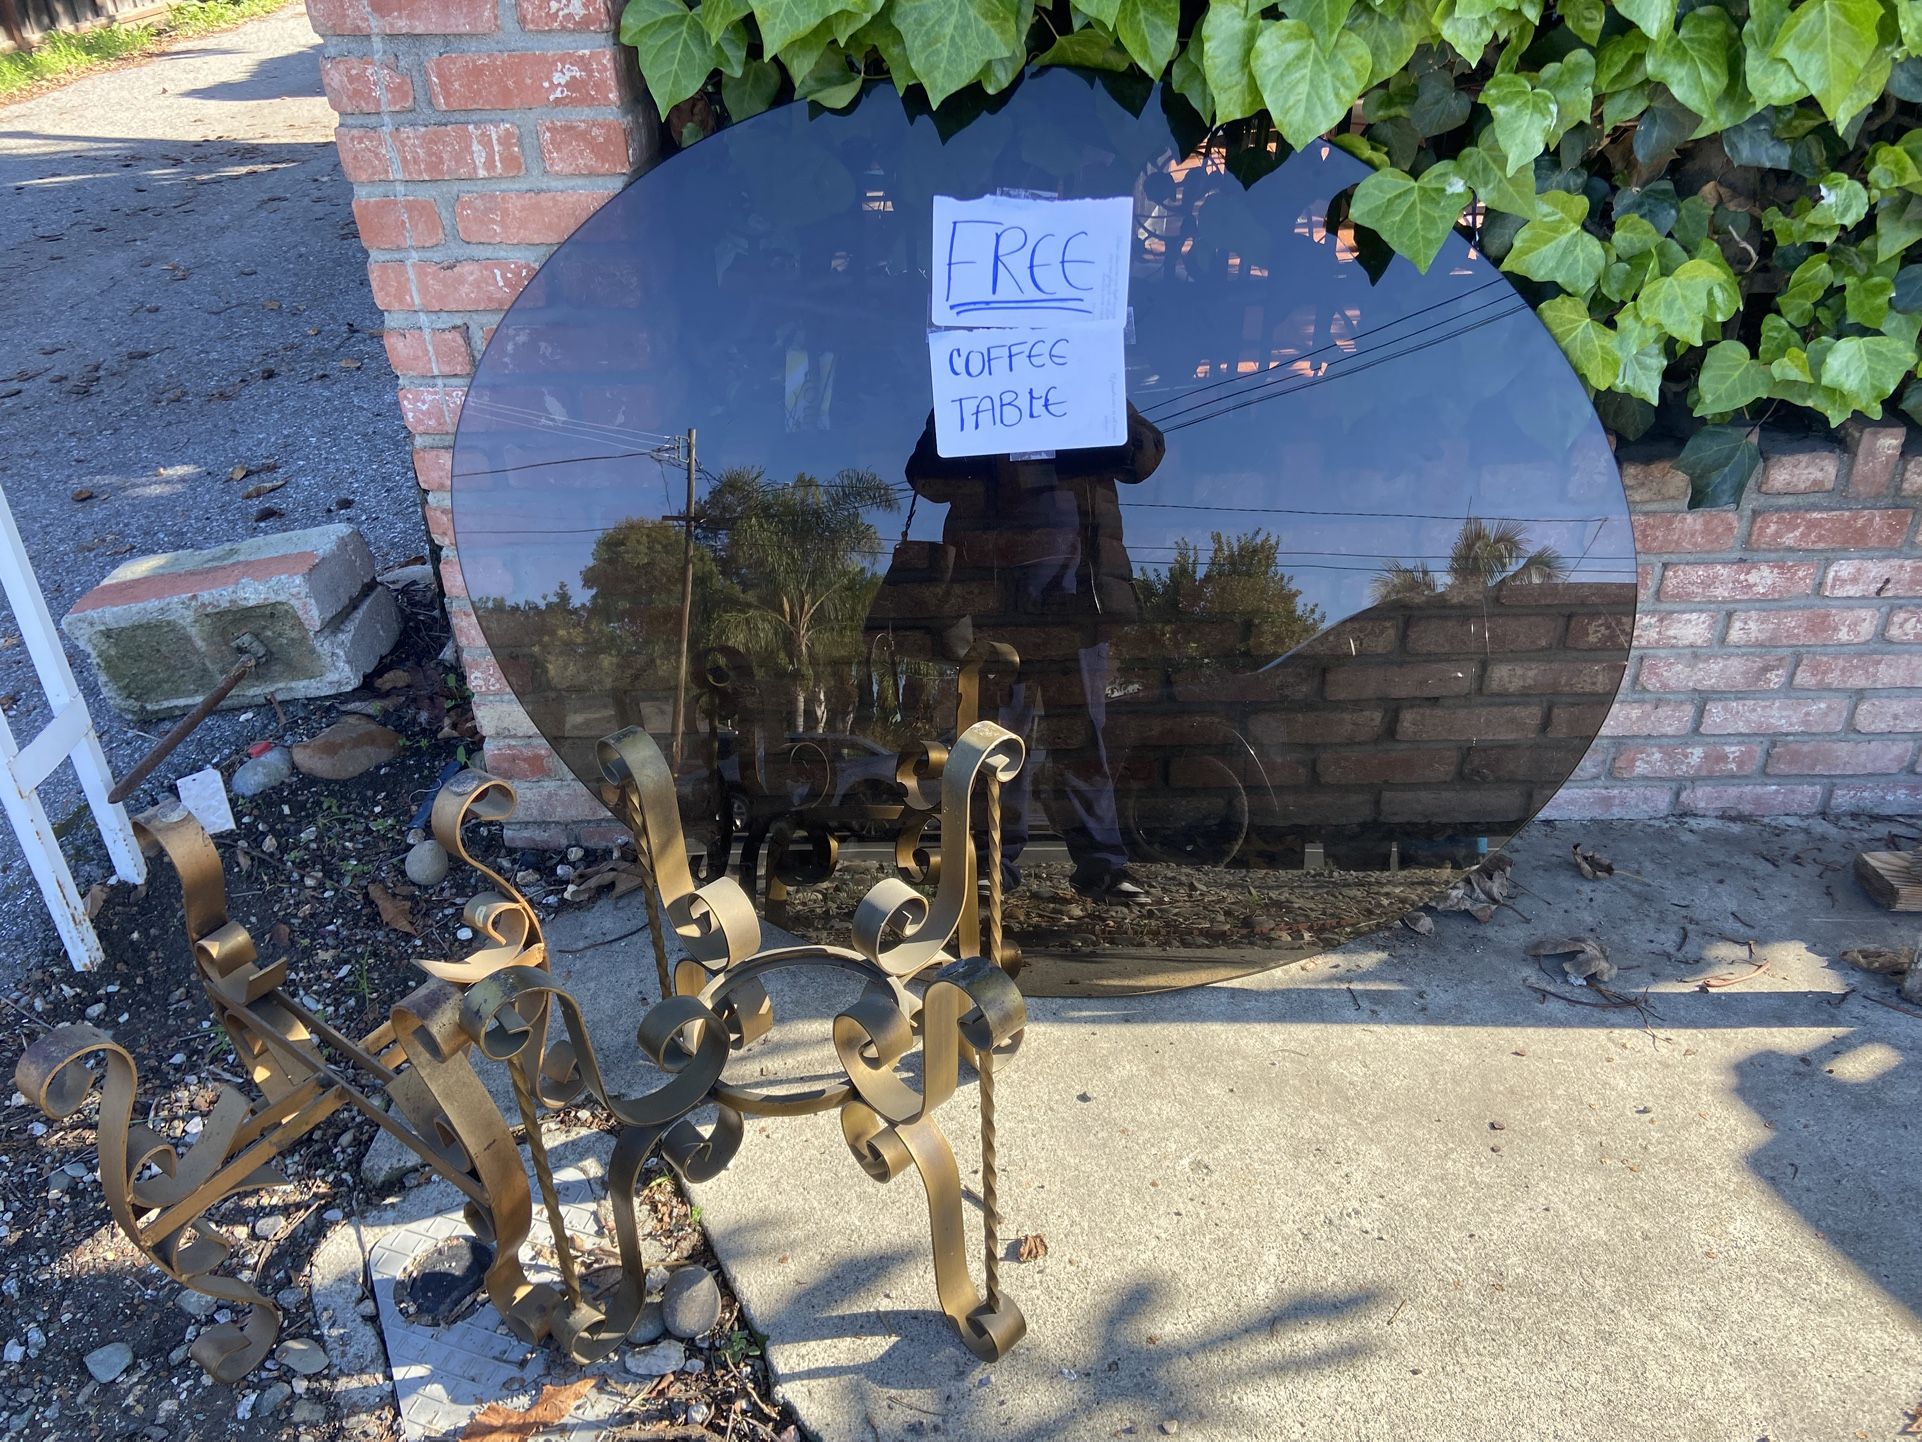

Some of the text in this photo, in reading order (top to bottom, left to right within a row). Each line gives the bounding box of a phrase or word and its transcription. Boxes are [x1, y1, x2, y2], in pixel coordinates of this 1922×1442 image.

[946, 220, 1095, 301] FREE
[948, 338, 1069, 378] COFFEE
[951, 386, 1067, 432] TABLE
